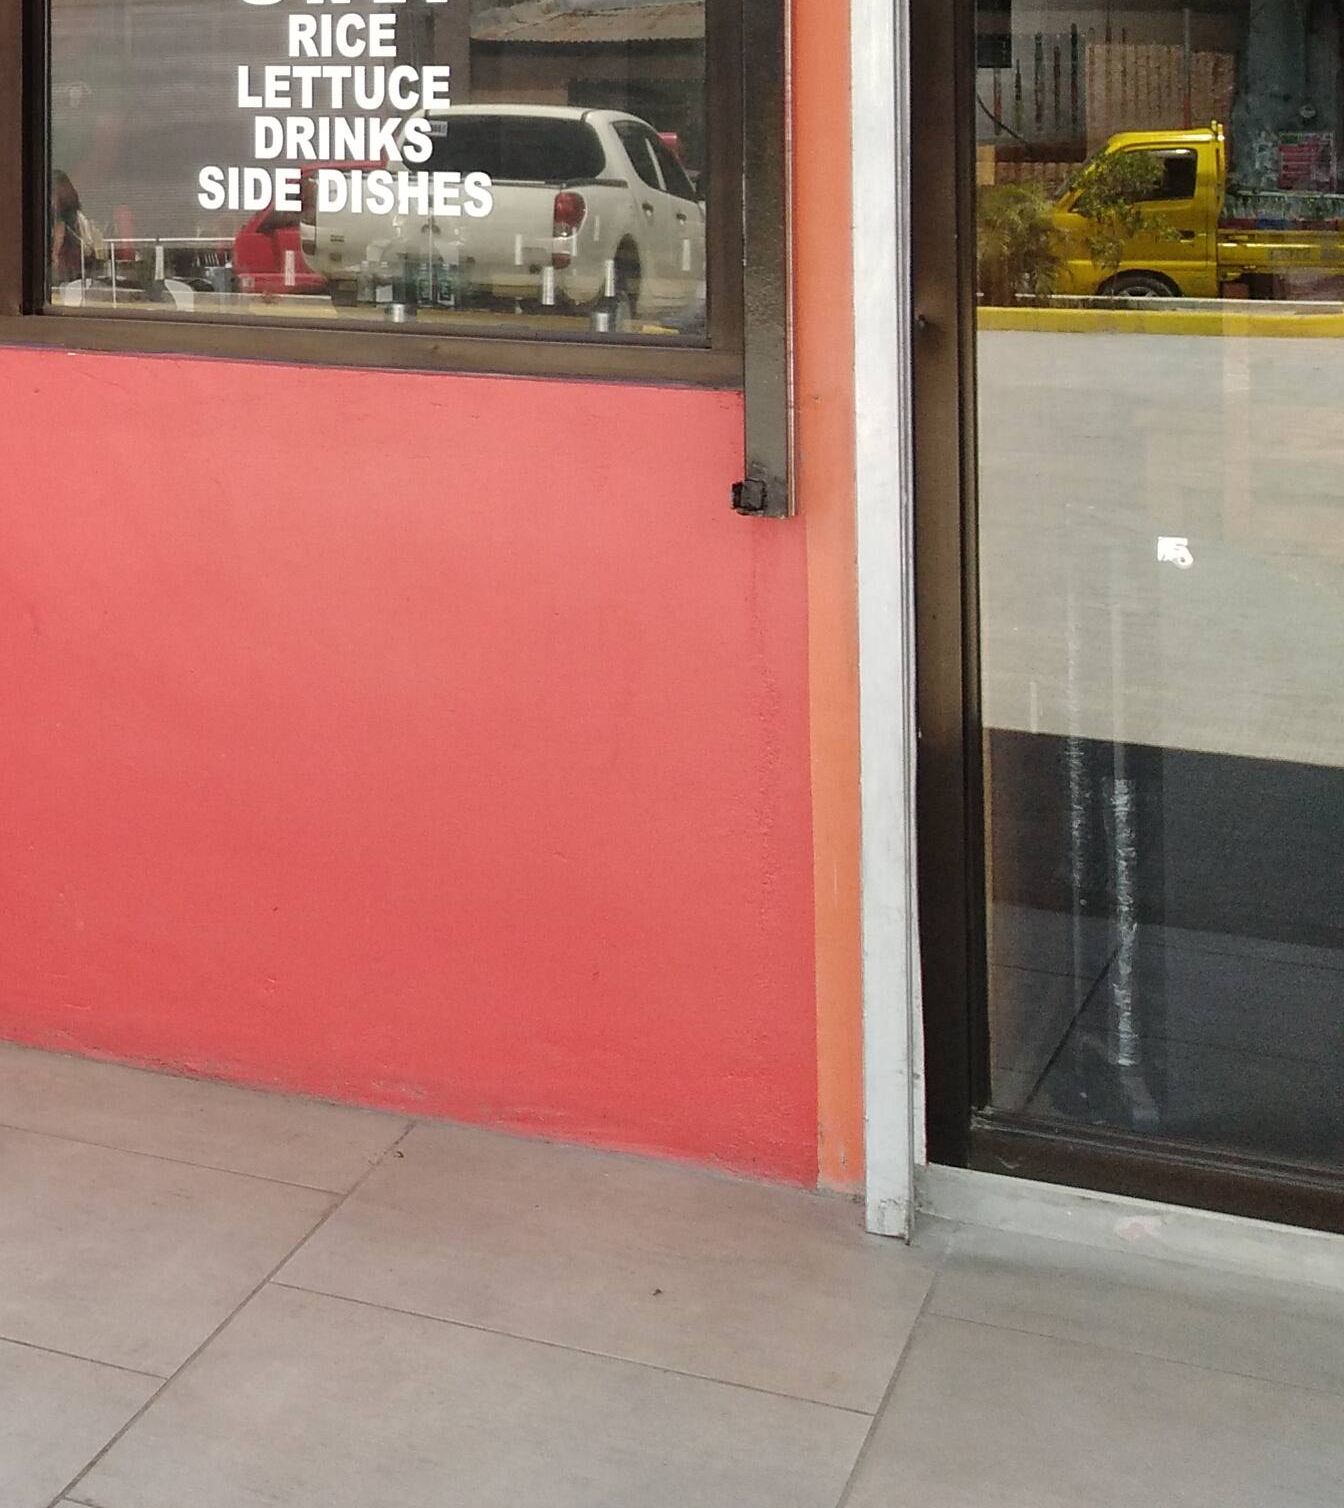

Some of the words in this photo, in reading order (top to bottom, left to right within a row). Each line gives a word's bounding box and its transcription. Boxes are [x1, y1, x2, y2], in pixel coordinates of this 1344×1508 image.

[288, 13, 397, 58] RICE
[238, 65, 451, 110] LETTUCE
[254, 116, 433, 163] DRINKS
[198, 166, 302, 212] SIDE
[317, 169, 493, 218] DISHES
